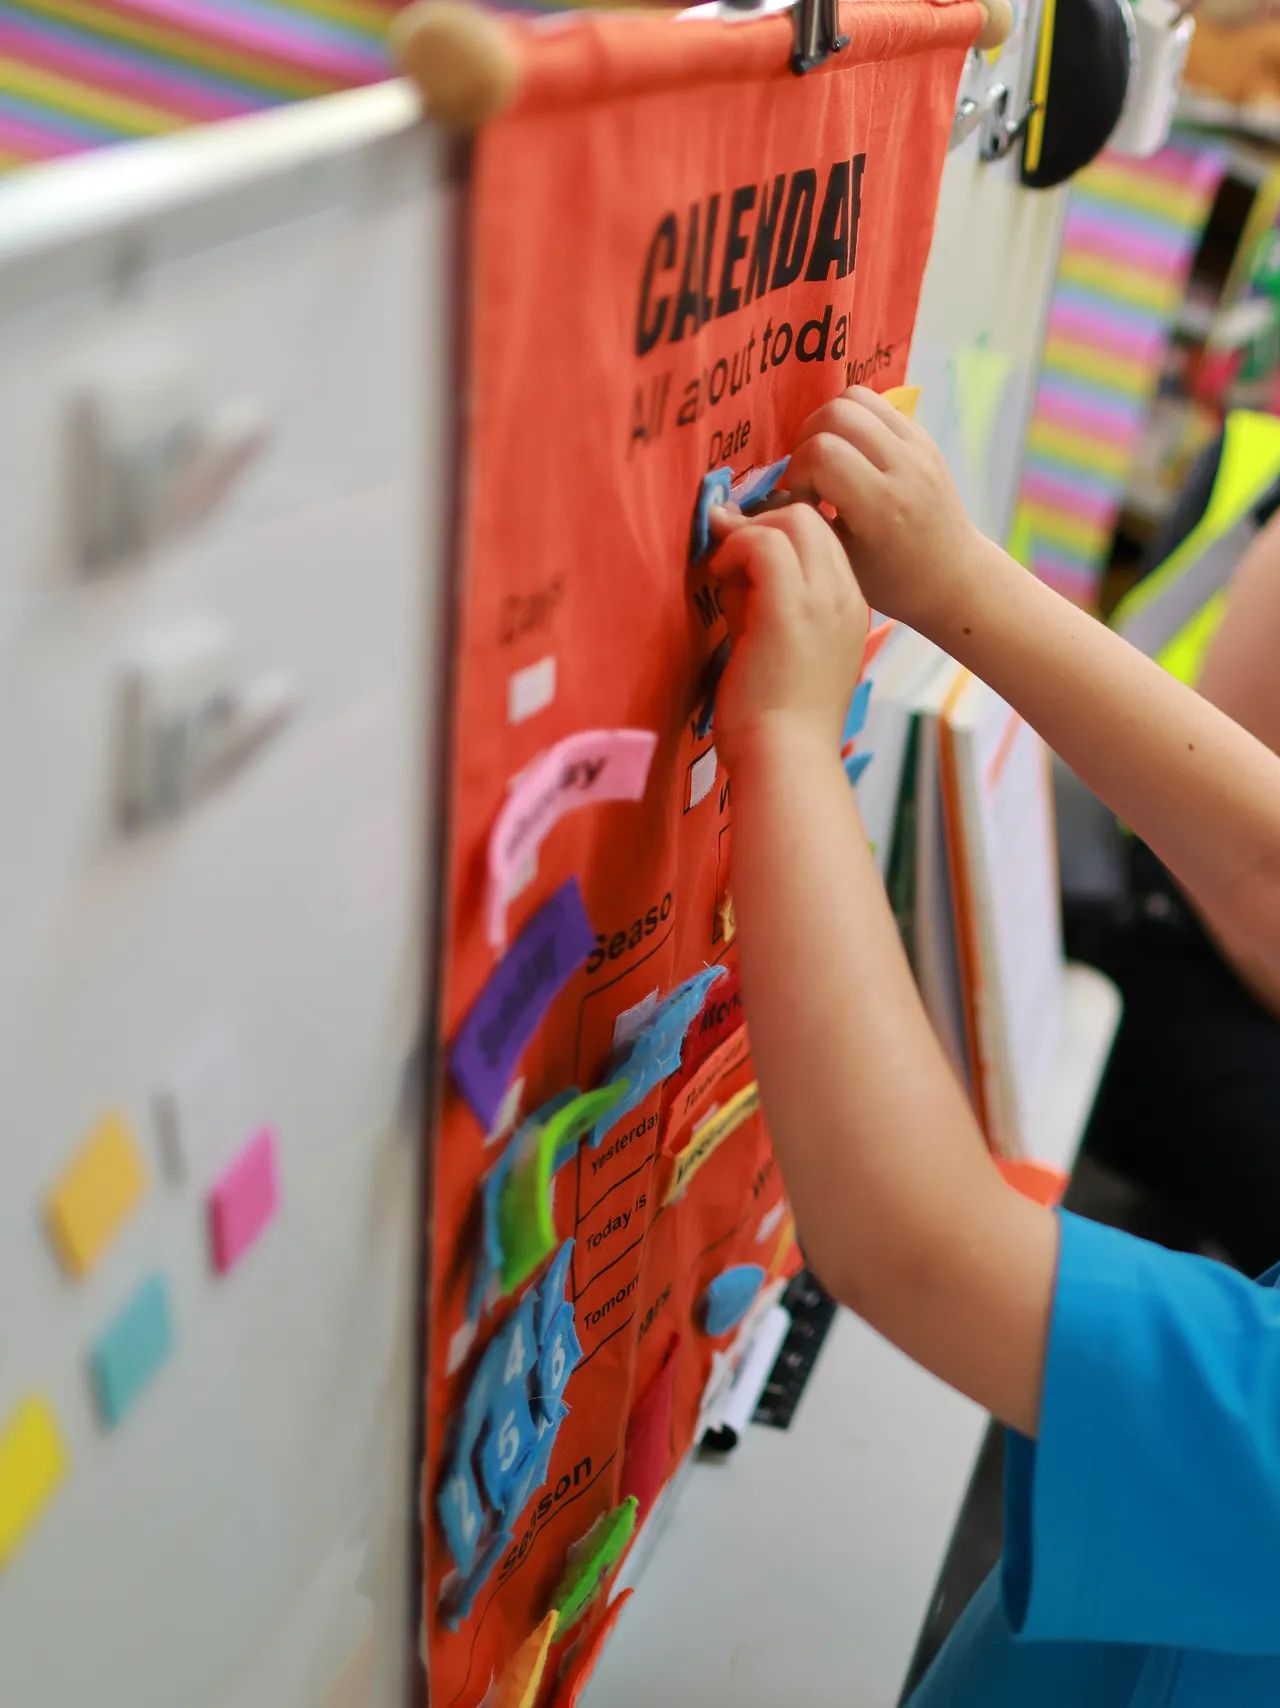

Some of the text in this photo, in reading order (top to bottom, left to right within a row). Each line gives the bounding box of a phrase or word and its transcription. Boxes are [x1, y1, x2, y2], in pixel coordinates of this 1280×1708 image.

[759, 304, 851, 374] toda
[707, 419, 751, 470] Date
[586, 891, 672, 975] Seaso
[585, 1193, 647, 1252] Today is
[583, 1274, 640, 1331] Tomorr
[503, 1322, 526, 1386] 4
[551, 1332, 566, 1390] 6
